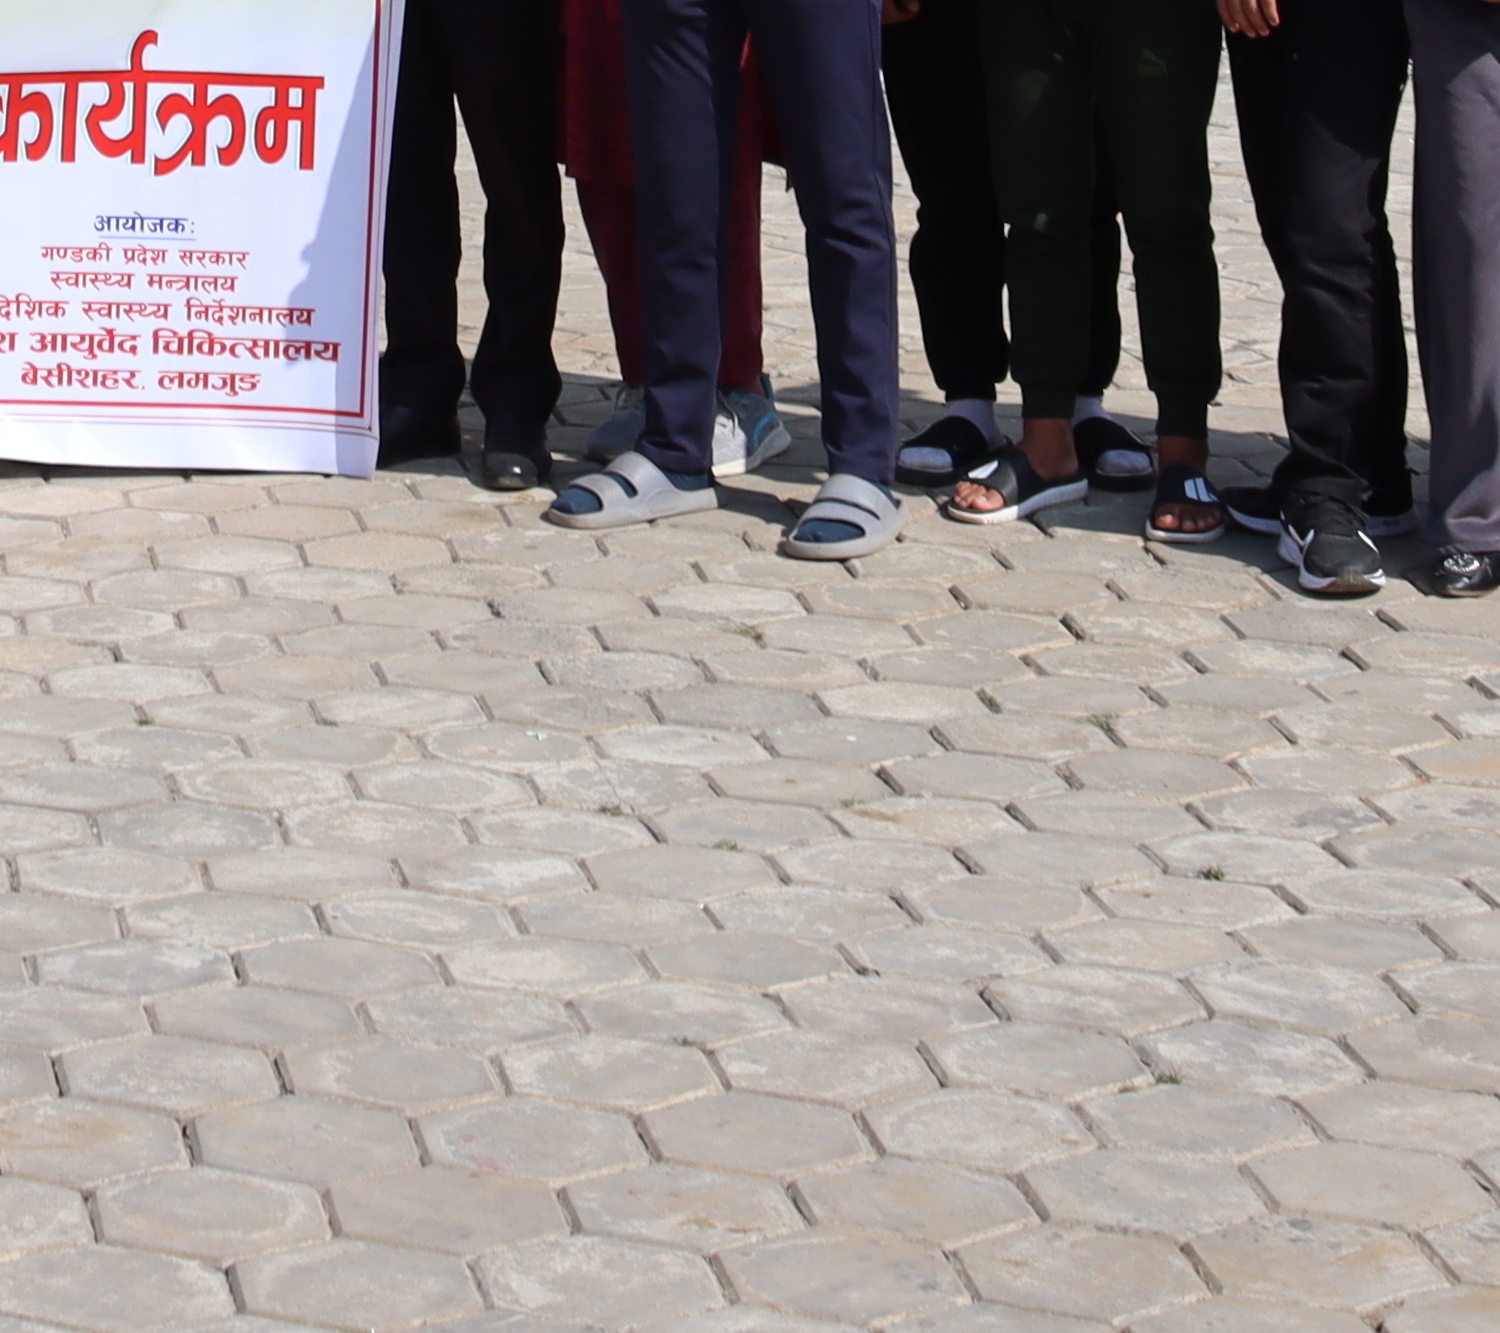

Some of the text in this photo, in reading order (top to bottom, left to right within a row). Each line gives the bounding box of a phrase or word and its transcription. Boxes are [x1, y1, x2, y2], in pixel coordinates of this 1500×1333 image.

[41, 242, 250, 270] गण्डकी प्रदेश सरकार
[50, 271, 239, 294] स्वास्थ्य मन्त्रालय
[82, 300, 172, 323] स्वास्थ्य
[186, 297, 316, 328] निर्देशनालय
[29, 327, 141, 360] आयुर्वेद
[152, 328, 342, 363] चिकित्सालय
[158, 371, 261, 397] लमजुङ
